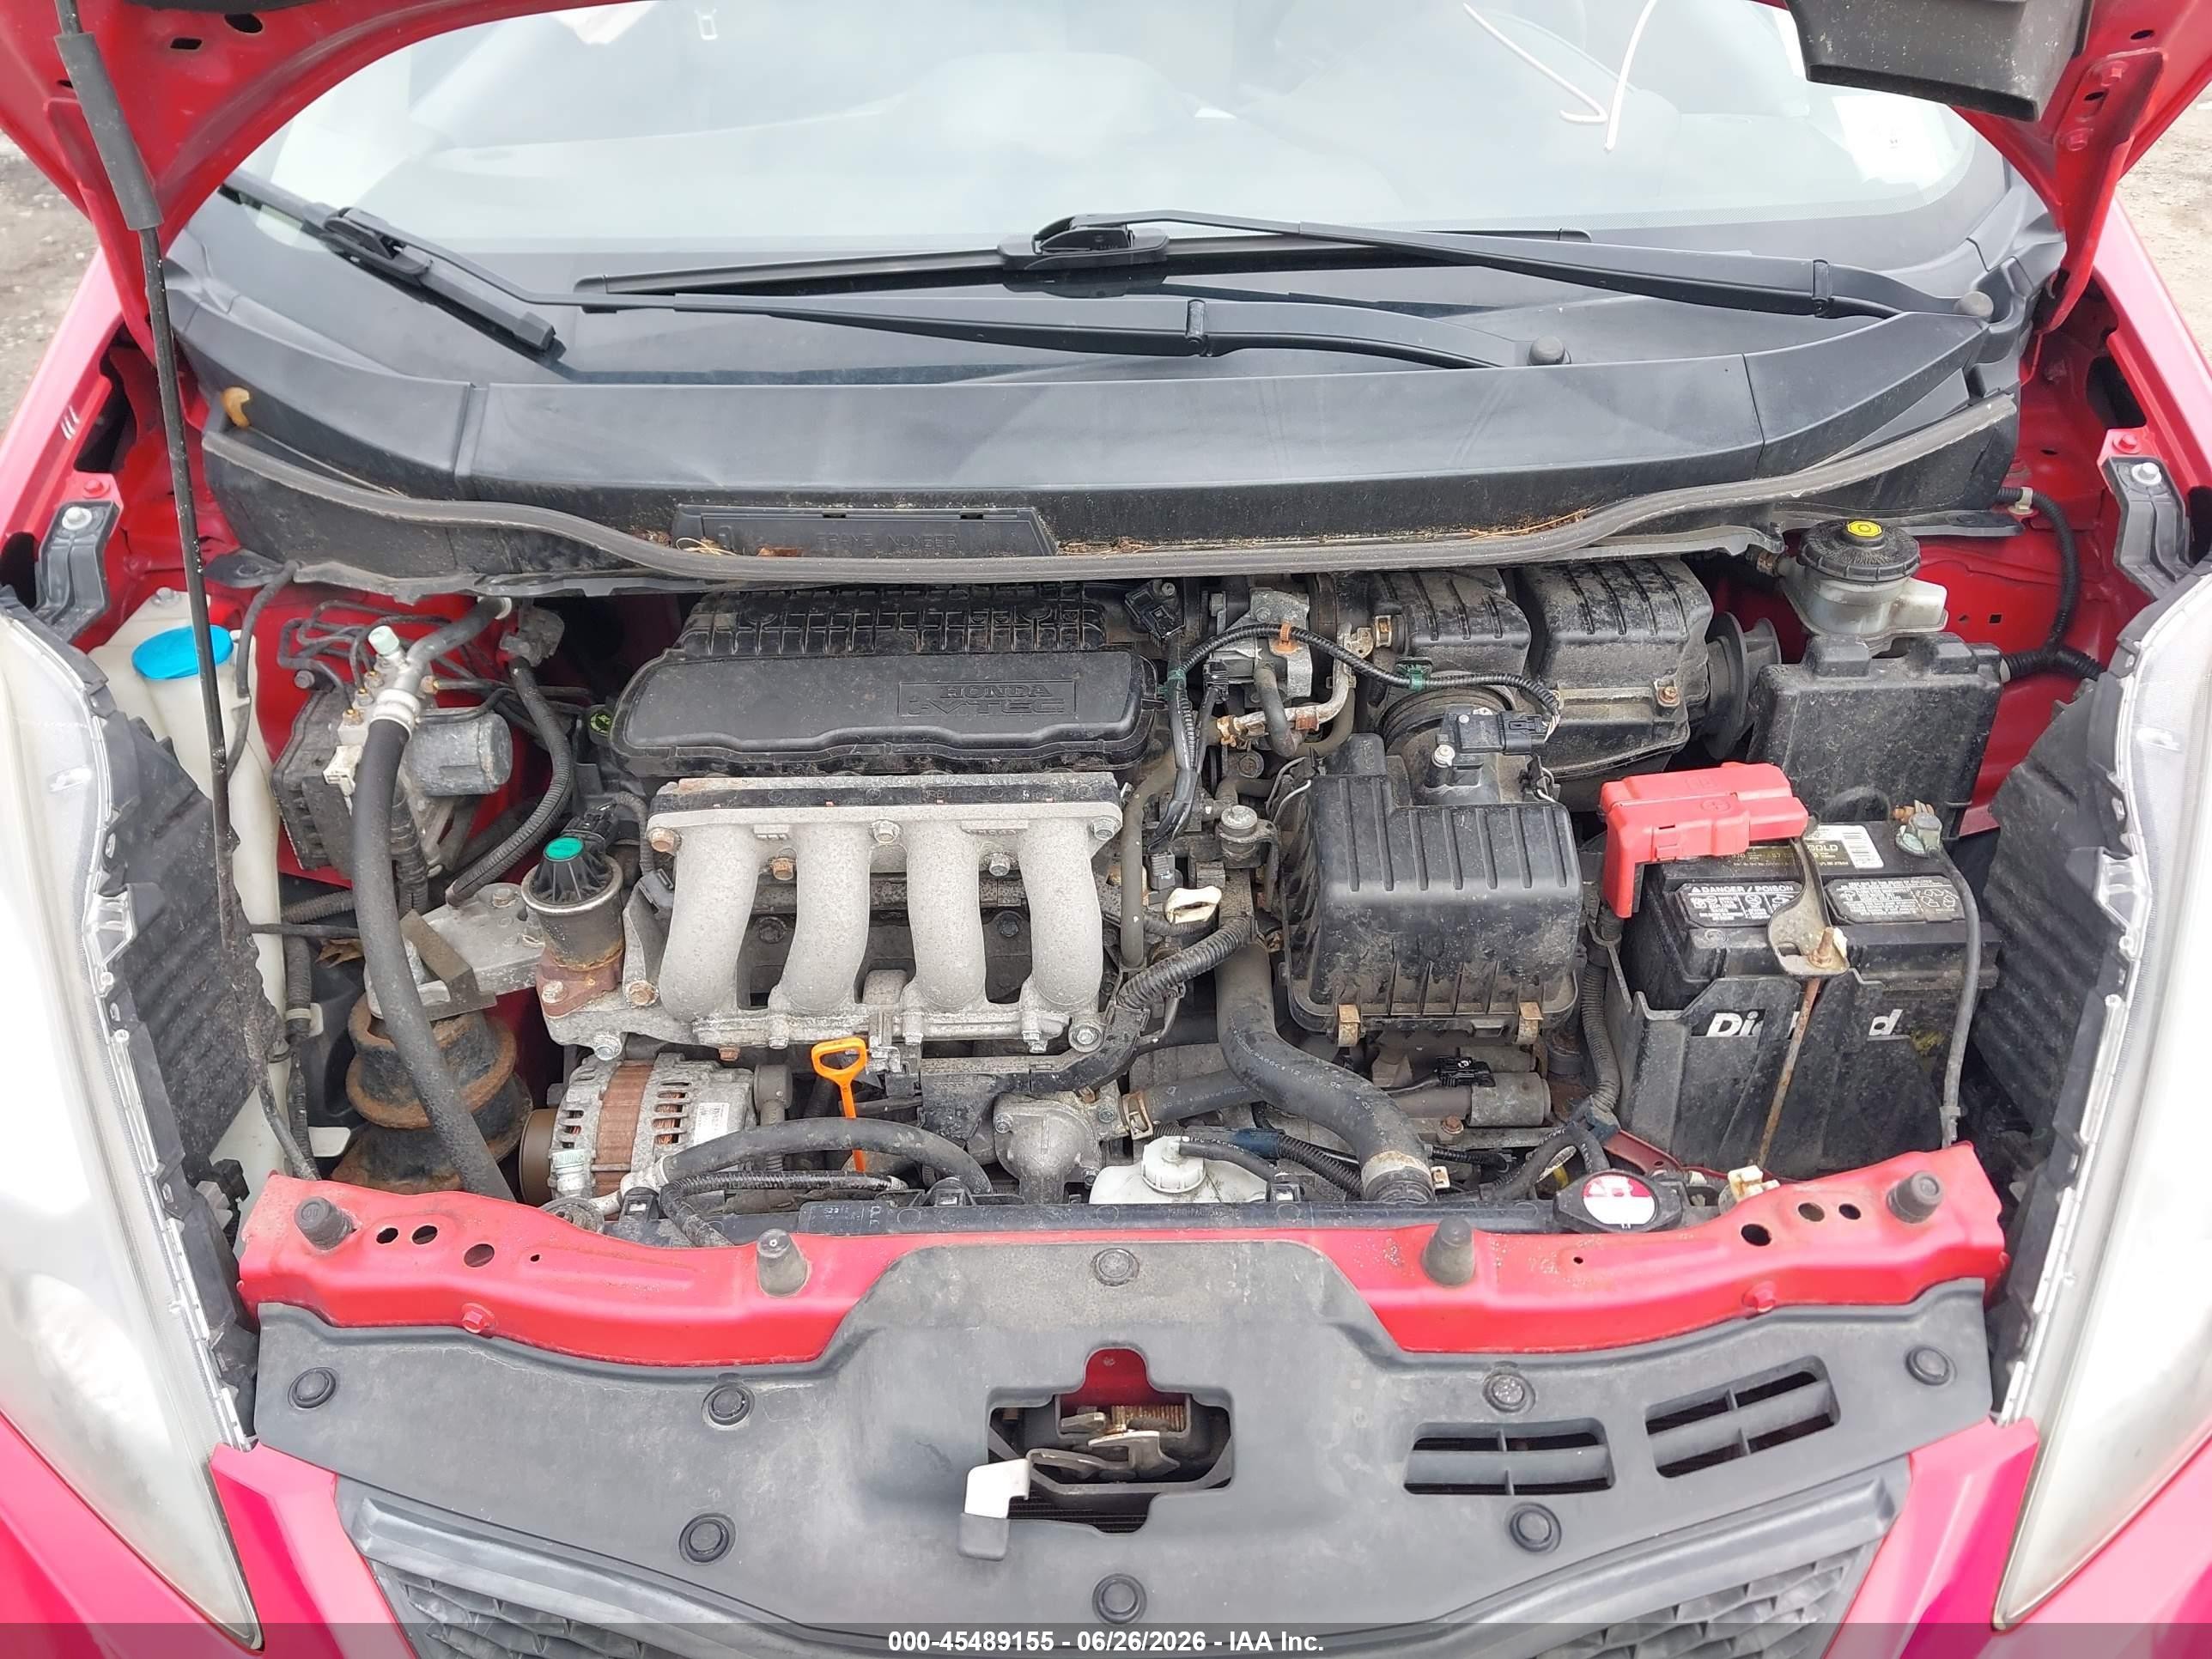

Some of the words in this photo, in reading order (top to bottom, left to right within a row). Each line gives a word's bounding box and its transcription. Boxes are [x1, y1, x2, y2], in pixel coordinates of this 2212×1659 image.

[816, 532, 873, 548] FRAME
[886, 533, 959, 550] NUMBER
[940, 684, 1053, 698] HONDA
